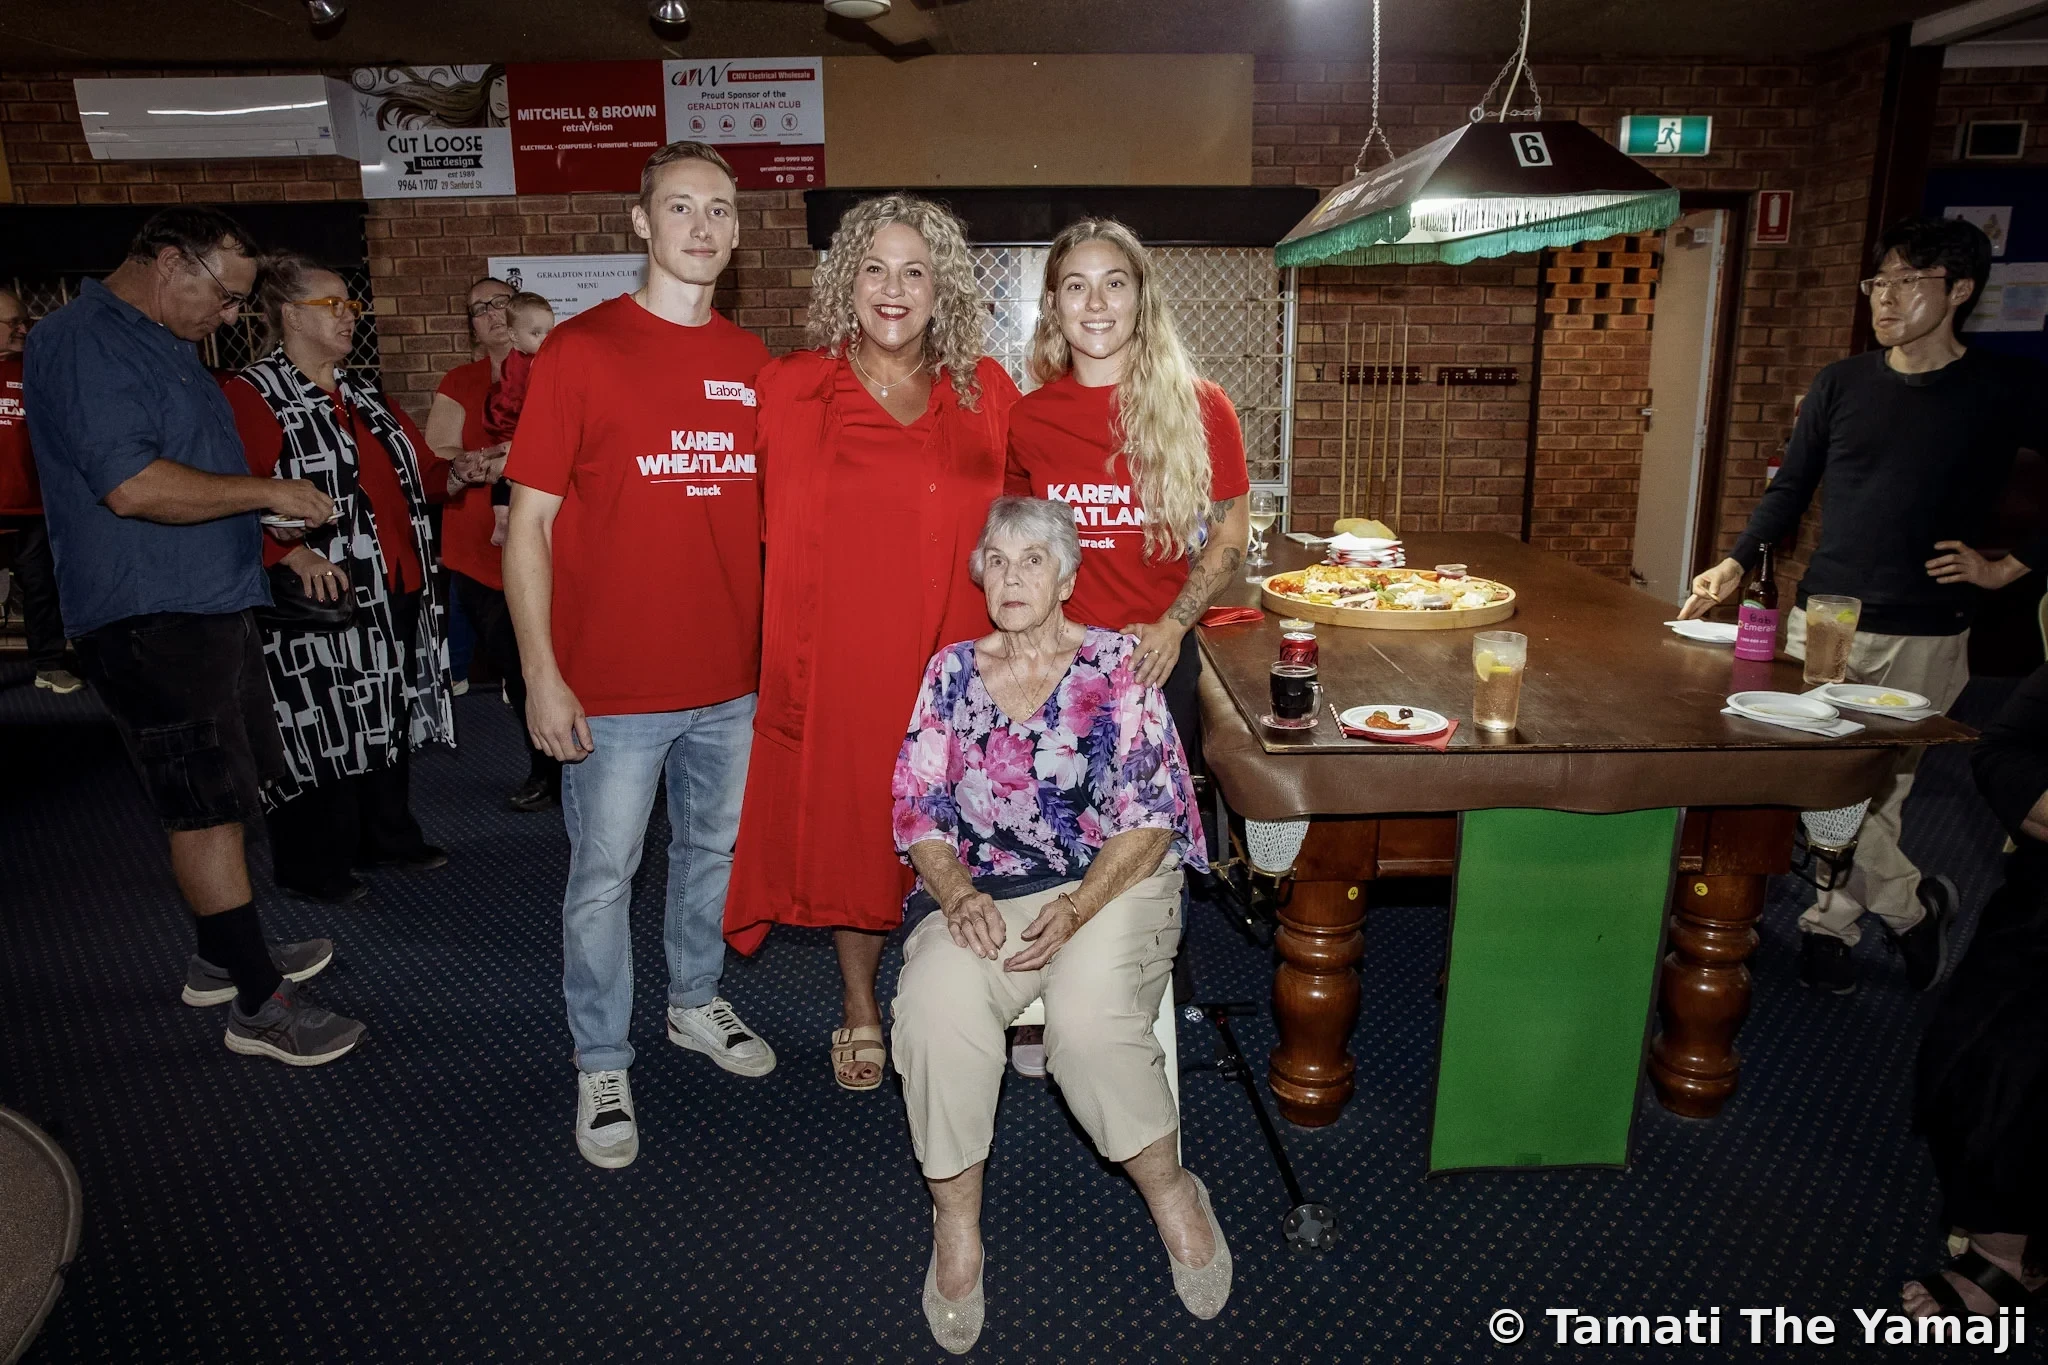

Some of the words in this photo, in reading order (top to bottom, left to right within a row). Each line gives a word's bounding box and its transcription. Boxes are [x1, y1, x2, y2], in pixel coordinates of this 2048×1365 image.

[748, 71, 777, 80] Electrical
[779, 69, 811, 79] Wholesale
[701, 91, 725, 99] Proud
[728, 90, 760, 99] Sponsor
[762, 90, 771, 98] of
[773, 90, 786, 98] the
[687, 102, 739, 110] GERALDTON
[742, 101, 775, 109] ITALIAN
[518, 107, 585, 120] MITCHELL
[588, 106, 599, 119] &
[601, 104, 656, 118] BROWN
[563, 121, 613, 132] retraVision
[424, 134, 483, 152] LOOSE
[558, 142, 592, 150] COMPUTERS
[597, 141, 628, 149] FURNITURE
[1519, 134, 1546, 164] 6
[420, 157, 441, 167] hair
[443, 157, 474, 168] design
[459, 170, 475, 178] 1989
[397, 179, 417, 191] 9964
[419, 179, 438, 190] 1707
[441, 181, 449, 190] 29
[450, 180, 475, 189] Sanford
[475, 180, 483, 189] St
[537, 271, 583, 279] GERALDTON
[584, 270, 615, 278] ITALIAN
[708, 383, 742, 397] Labor
[671, 430, 735, 451] KAREN
[1047, 484, 1130, 505] KAREN
[1078, 537, 1116, 549] urack
[1744, 623, 1776, 632] Emerald
